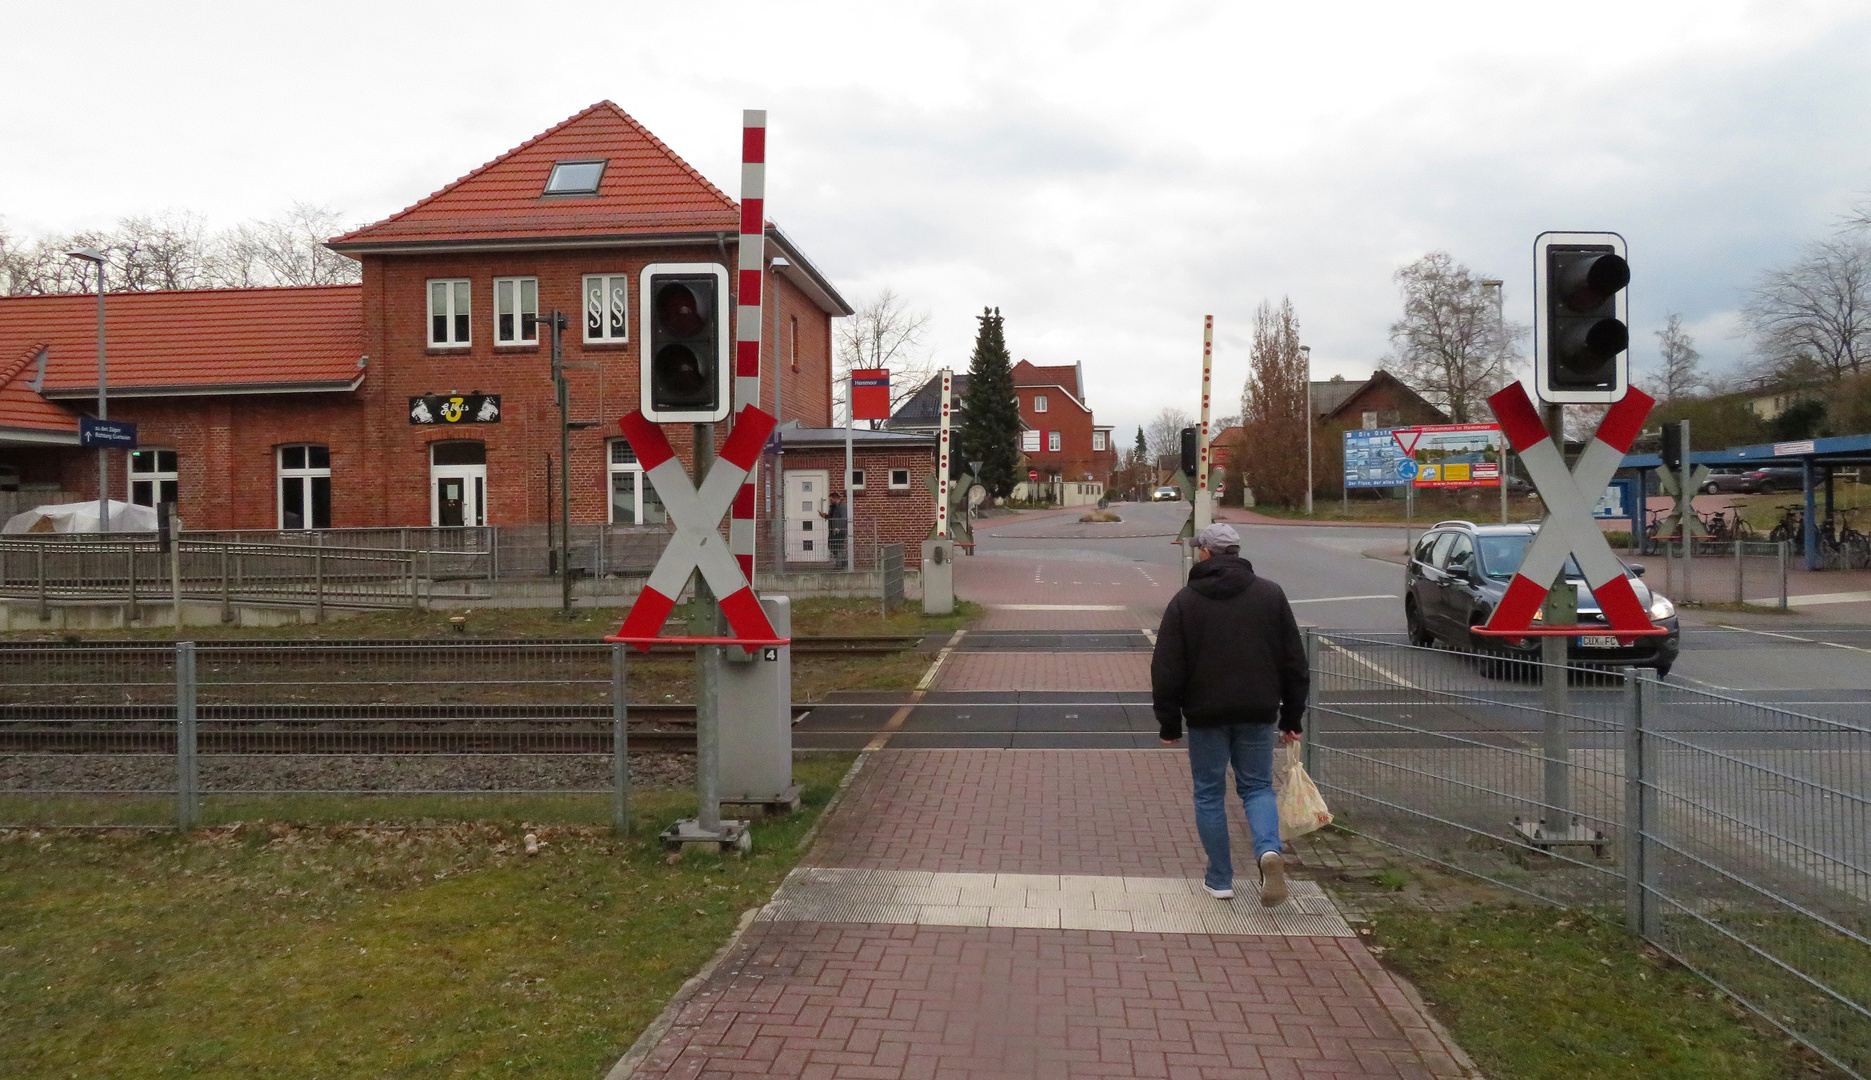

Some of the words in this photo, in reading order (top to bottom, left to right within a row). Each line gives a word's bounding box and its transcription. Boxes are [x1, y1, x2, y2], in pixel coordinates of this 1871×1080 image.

[446, 397, 464, 422] 3
[1583, 636, 1600, 646] CUX
[766, 649, 776, 660] 4
